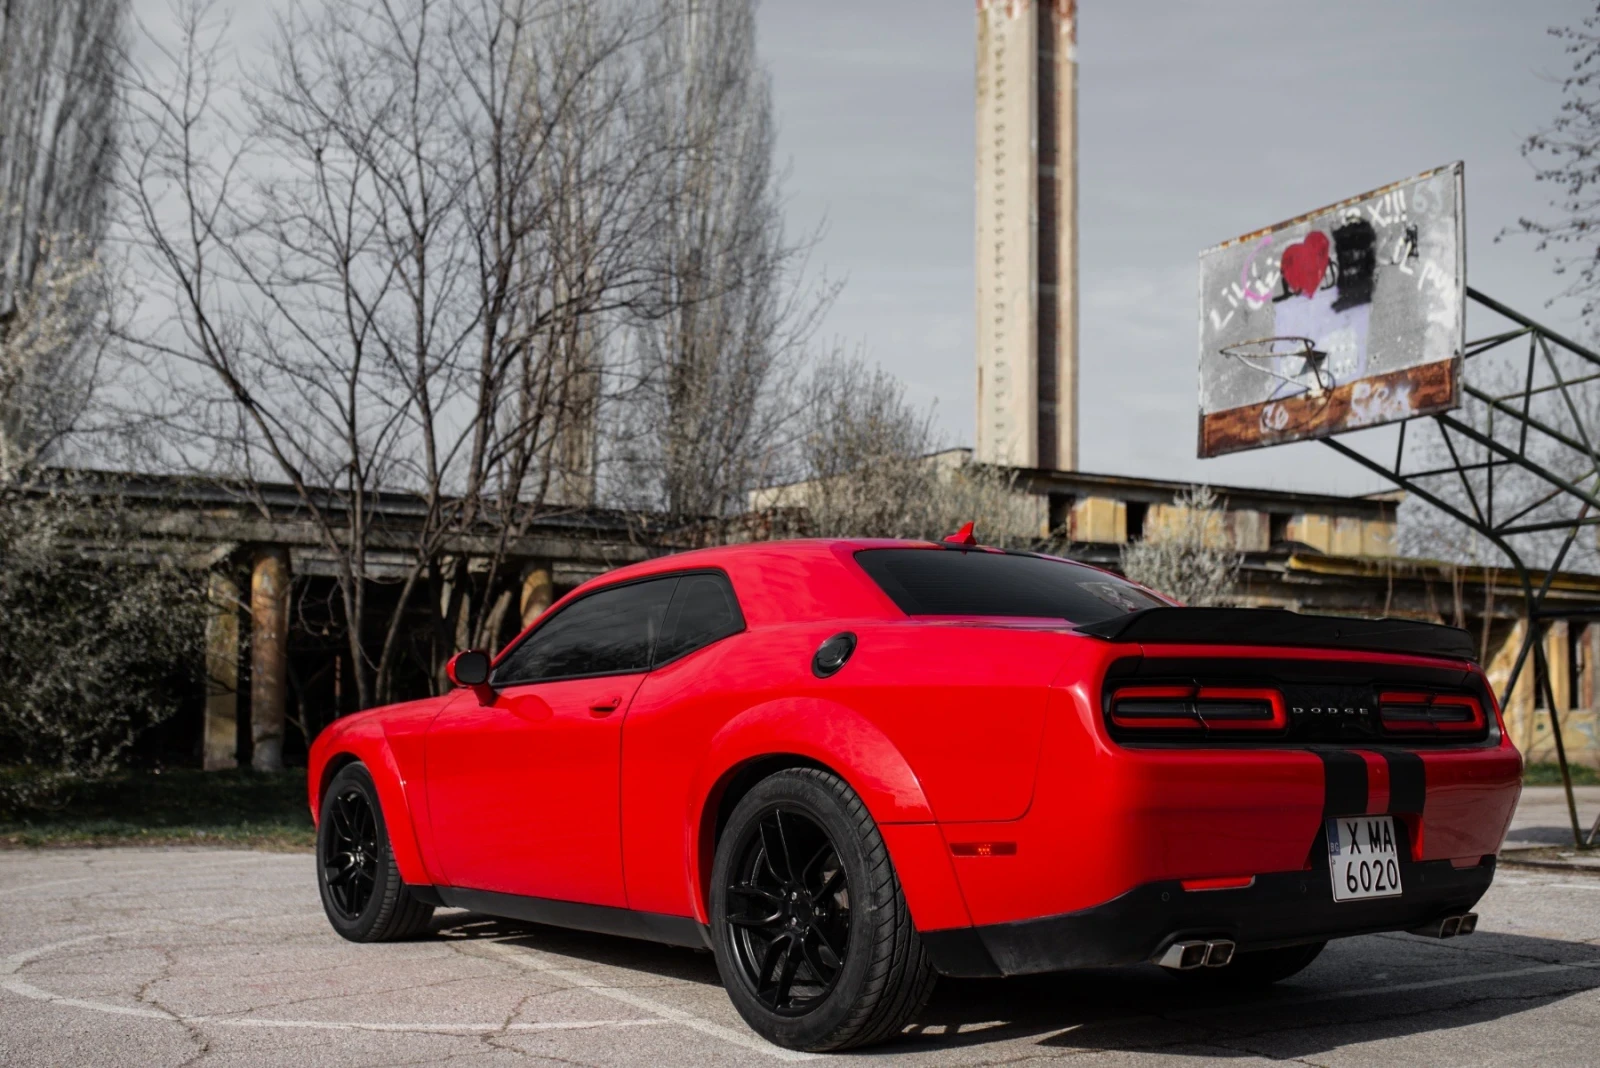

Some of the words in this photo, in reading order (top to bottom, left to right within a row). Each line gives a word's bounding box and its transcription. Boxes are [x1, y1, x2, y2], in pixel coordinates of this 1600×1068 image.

[1330, 842, 1339, 852] BG
[1347, 822, 1362, 854] X
[1367, 820, 1394, 853] MA
[1346, 859, 1397, 893] 6020
